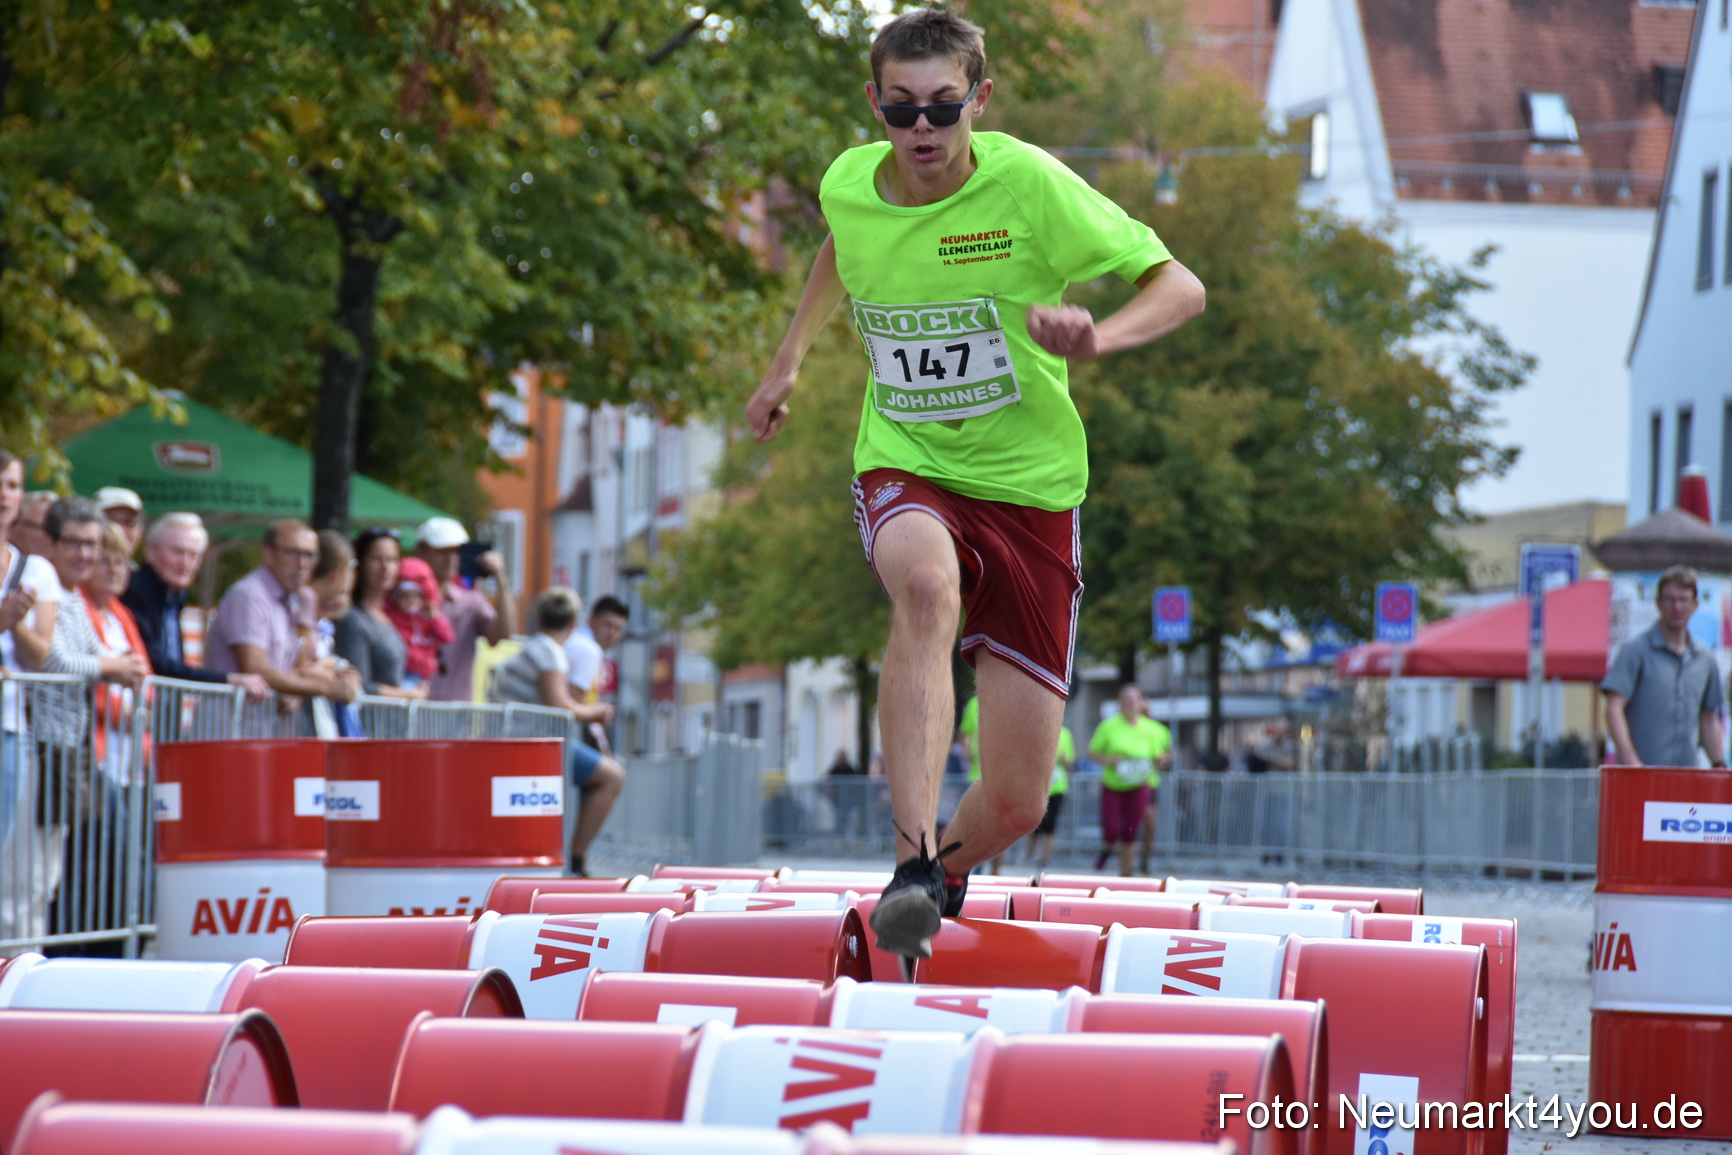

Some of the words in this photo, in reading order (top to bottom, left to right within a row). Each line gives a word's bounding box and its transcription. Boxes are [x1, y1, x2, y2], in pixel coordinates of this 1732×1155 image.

[940, 229, 1009, 245] NEUMARKTER
[938, 239, 1013, 256] ELEMENTELAUF
[954, 254, 994, 265] September
[994, 251, 1011, 260] 2019
[862, 306, 985, 337] BOCK
[989, 337, 1000, 345] E6
[892, 342, 971, 383] 147
[886, 382, 1003, 409] JOHANNES
